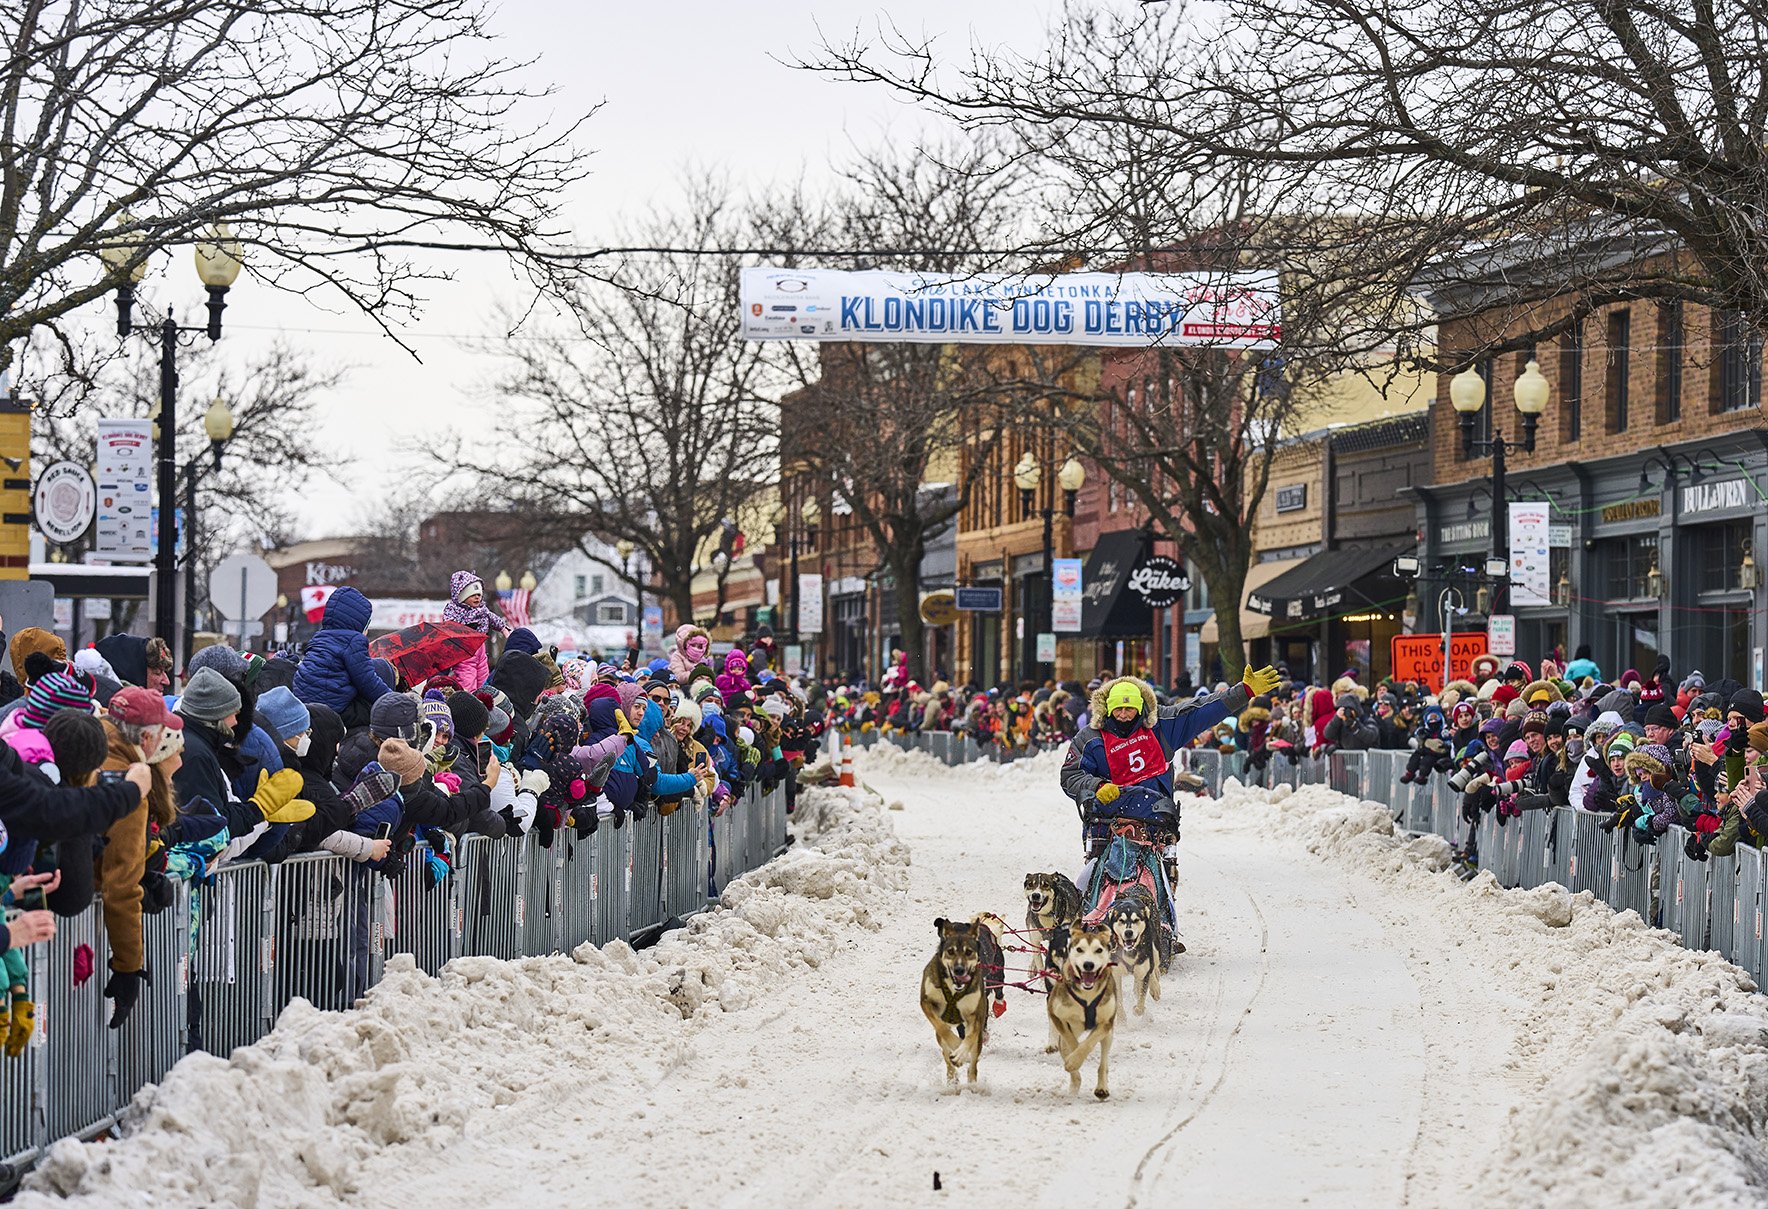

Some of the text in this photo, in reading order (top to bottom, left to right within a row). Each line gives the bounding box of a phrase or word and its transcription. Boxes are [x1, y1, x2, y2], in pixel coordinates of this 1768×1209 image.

[912, 278, 1113, 300] The LAKE MINNETONKA
[841, 296, 1184, 337] KLONDIKE DOG DERBY
[47, 467, 85, 482] RED SAUCE
[1684, 484, 1710, 514] BULL
[1716, 478, 1747, 508] WREN
[46, 520, 83, 536] REBELLION
[1128, 567, 1191, 595] Lakes
[1401, 643, 1481, 657] THIS OAD
[1128, 748, 1146, 773] 5
